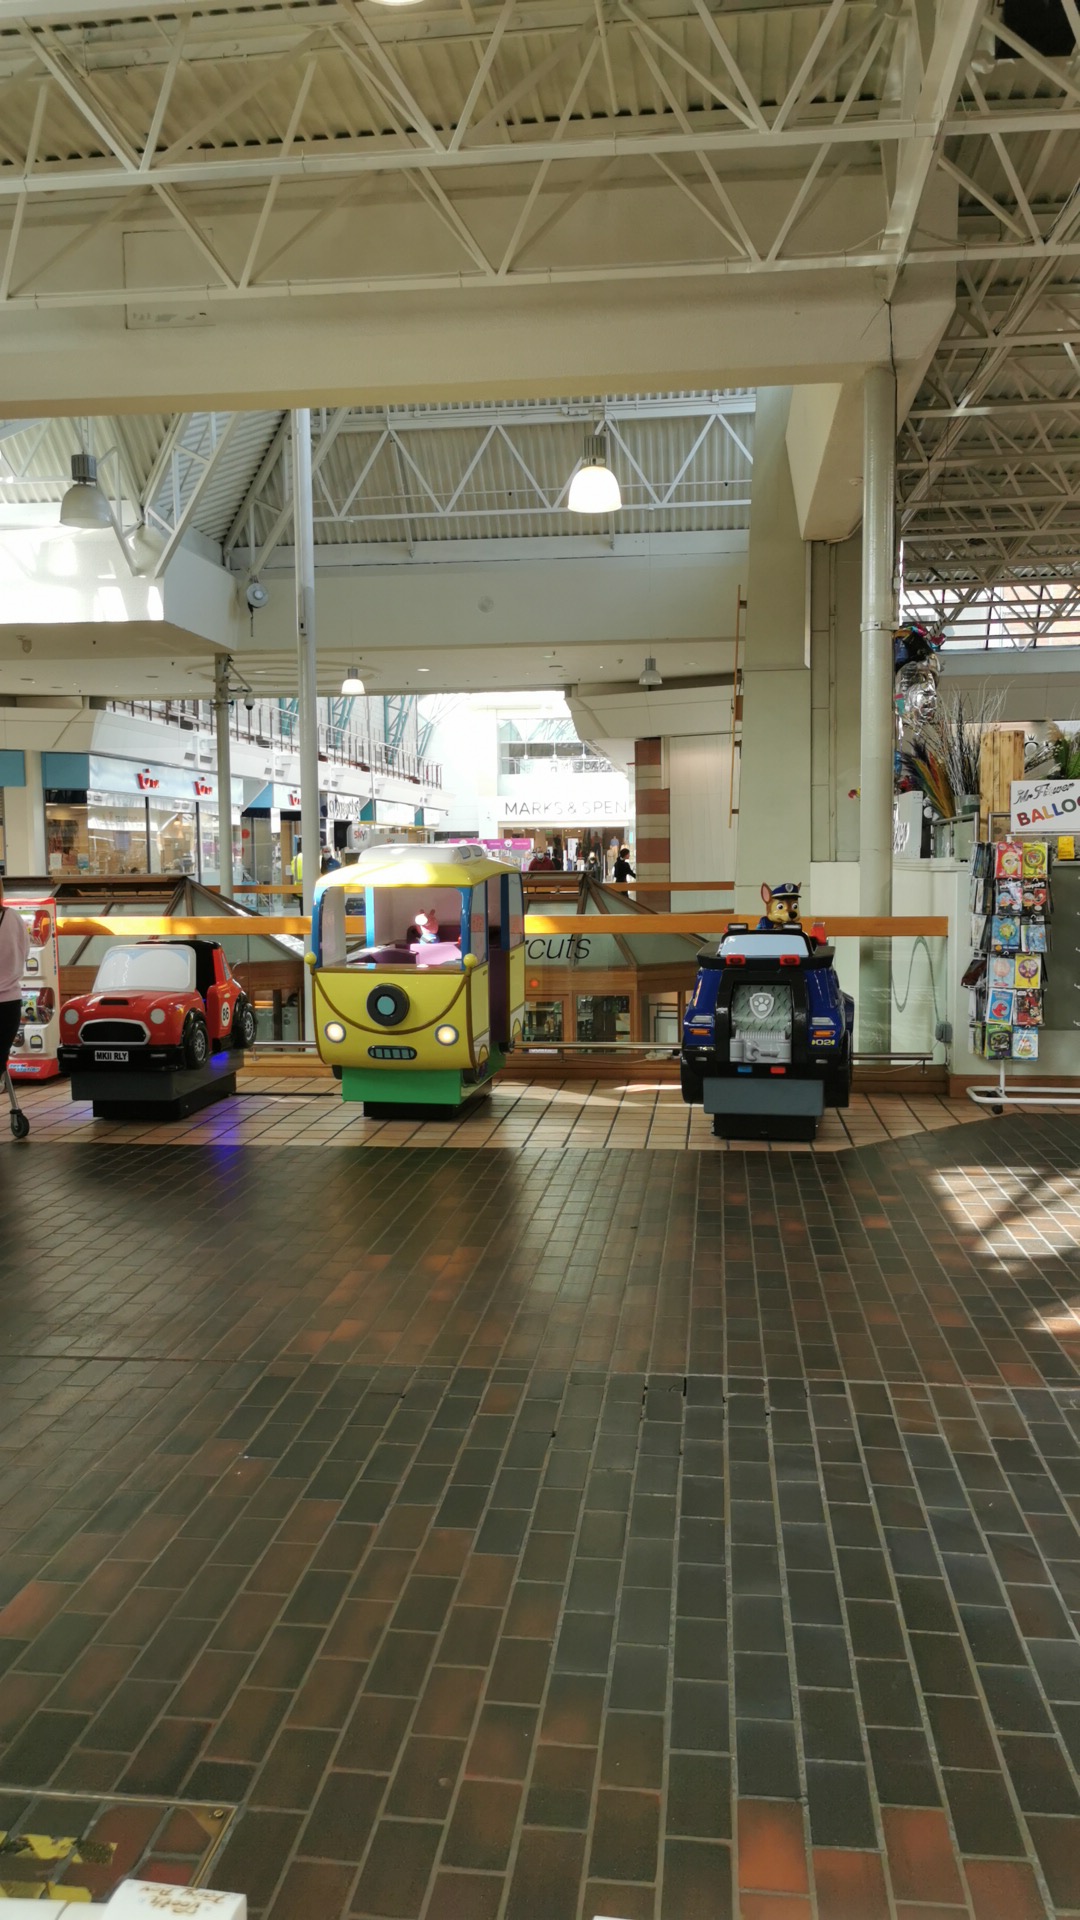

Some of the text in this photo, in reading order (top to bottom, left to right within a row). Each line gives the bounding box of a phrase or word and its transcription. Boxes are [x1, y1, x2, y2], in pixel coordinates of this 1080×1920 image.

[505, 802, 563, 815] MARKS
[567, 802, 577, 815] &
[1017, 795, 1080, 826] BALLO
[96, 1052, 127, 1060] MKII RLY
